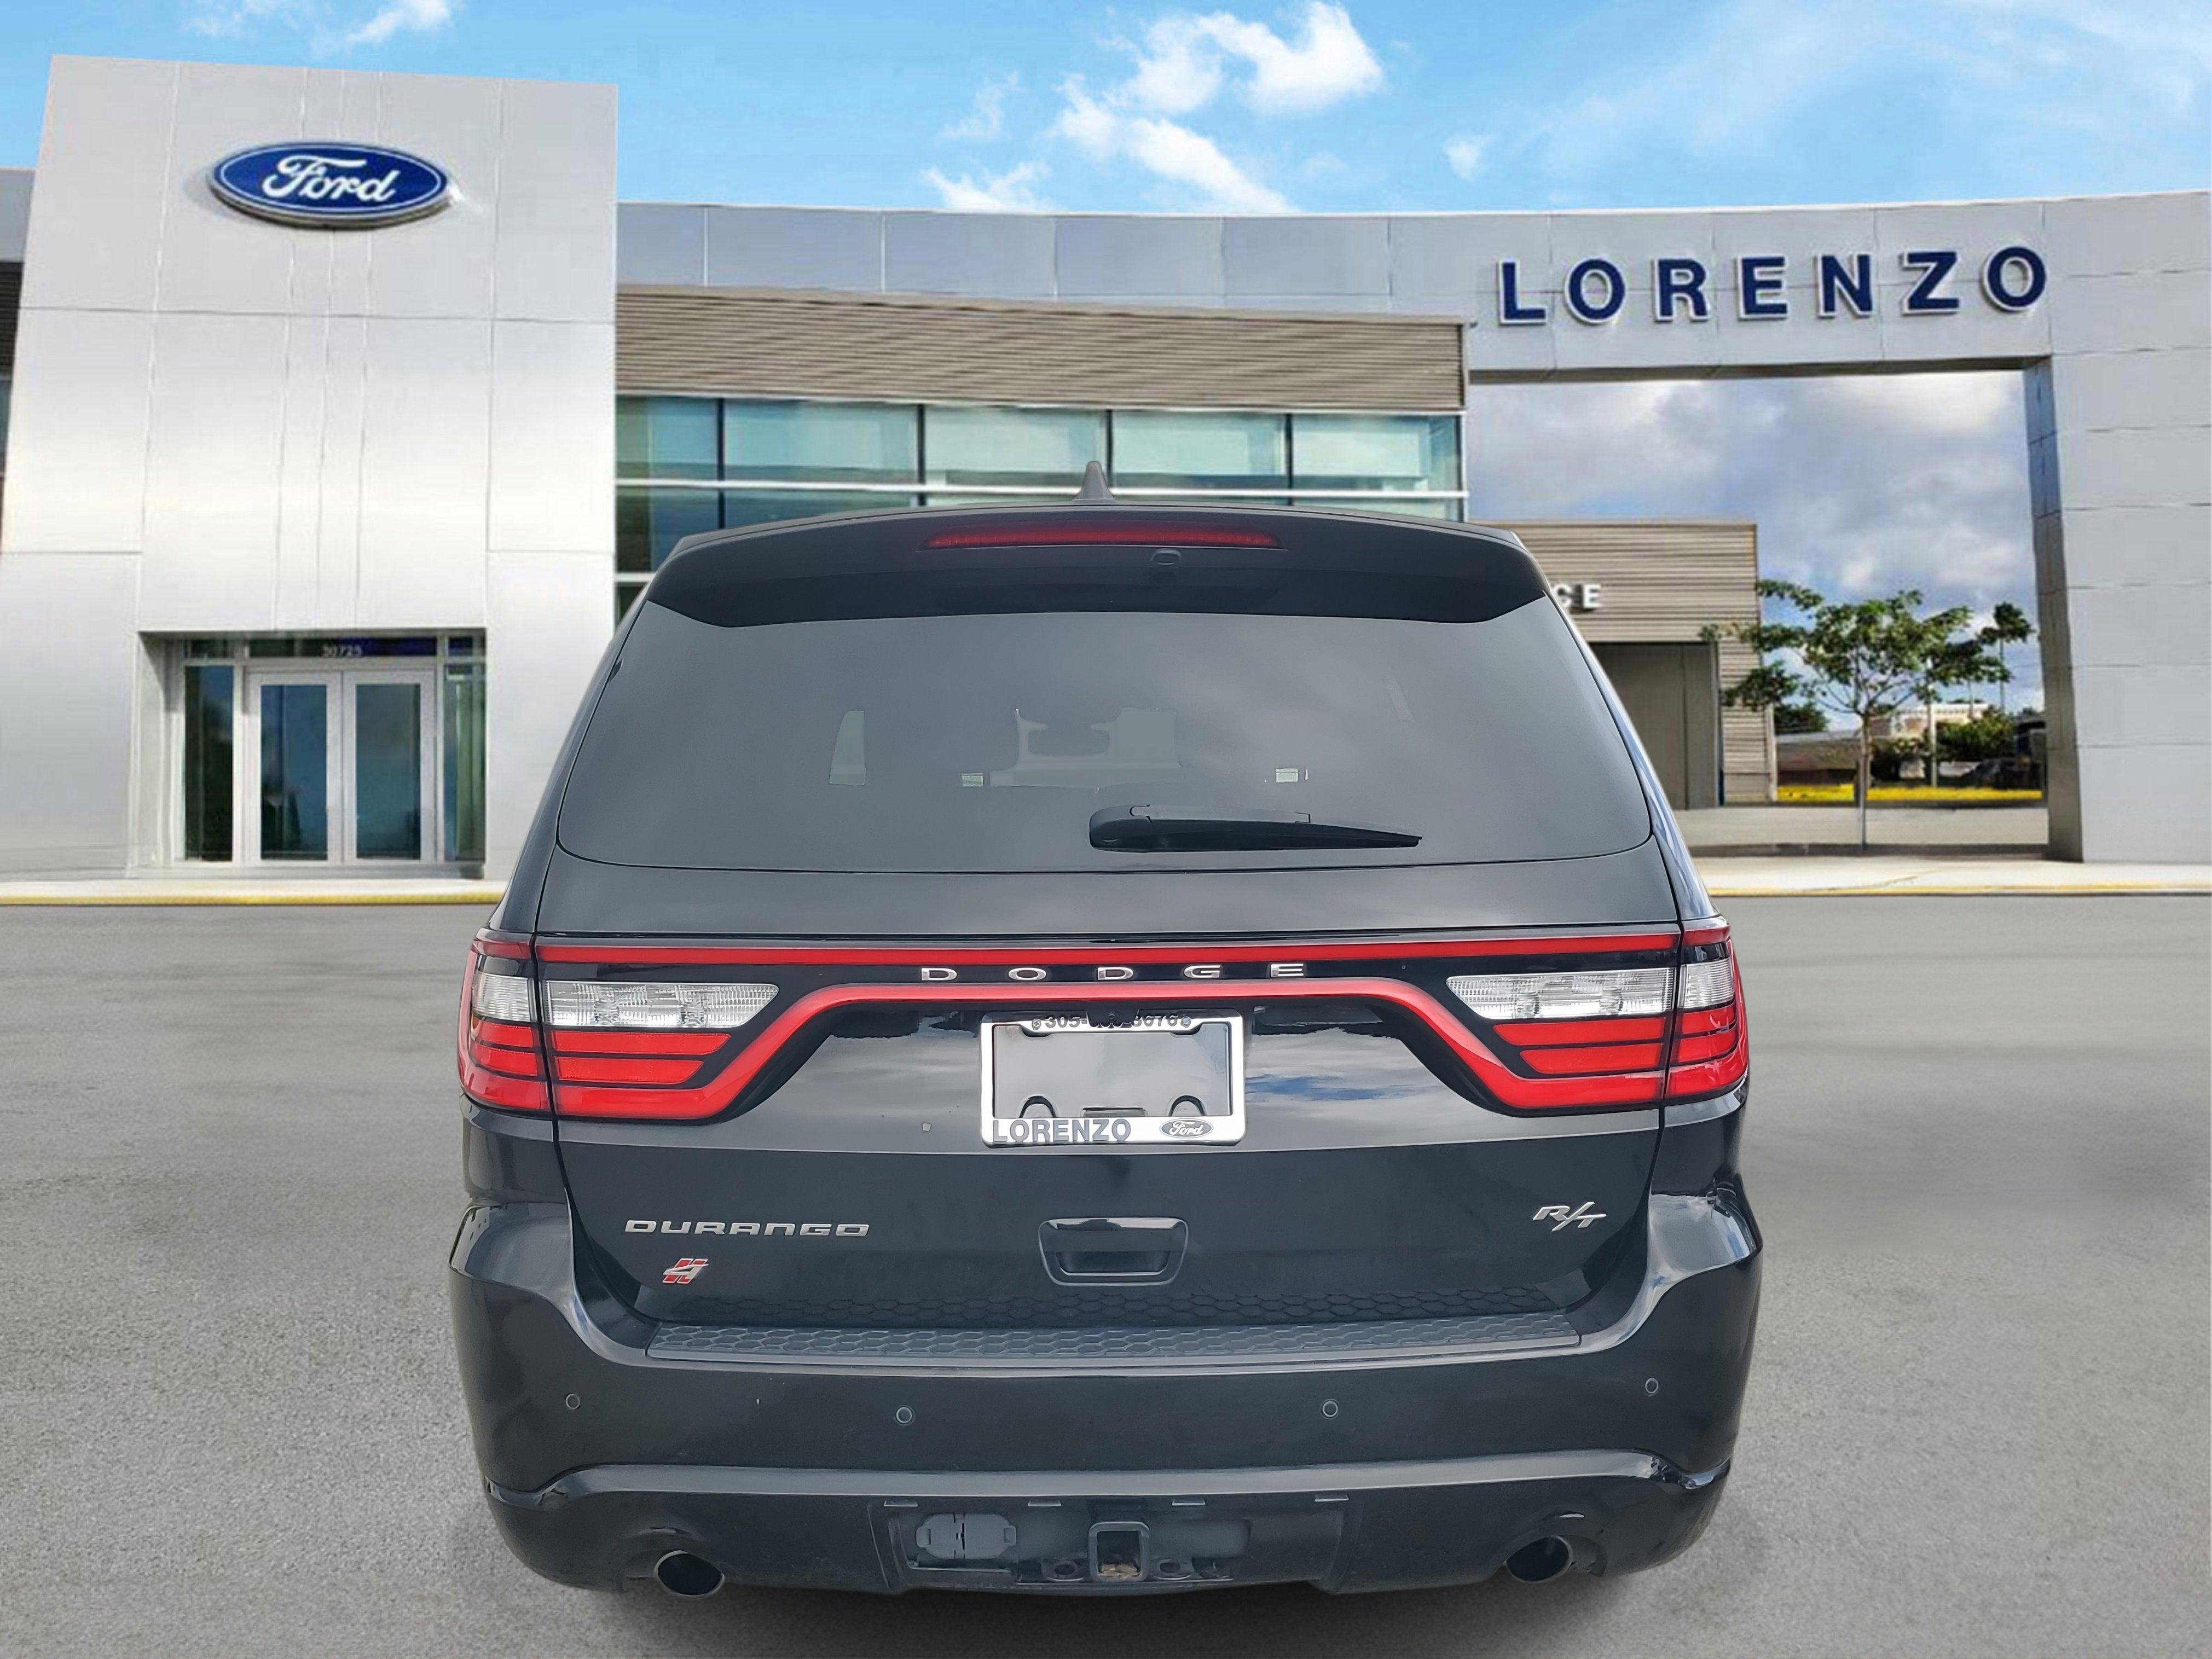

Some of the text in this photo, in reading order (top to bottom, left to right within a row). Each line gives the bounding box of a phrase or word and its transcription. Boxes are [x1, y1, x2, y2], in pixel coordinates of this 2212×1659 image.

[262, 155, 401, 202] Ford
[1498, 246, 2047, 324] LORENZO
[921, 963, 1305, 981] DODGE
[993, 1118, 1132, 1142] LORENZO
[1169, 1121, 1205, 1136] Ford
[624, 1220, 870, 1237] DURANGO
[1532, 1201, 1607, 1232] R/T
